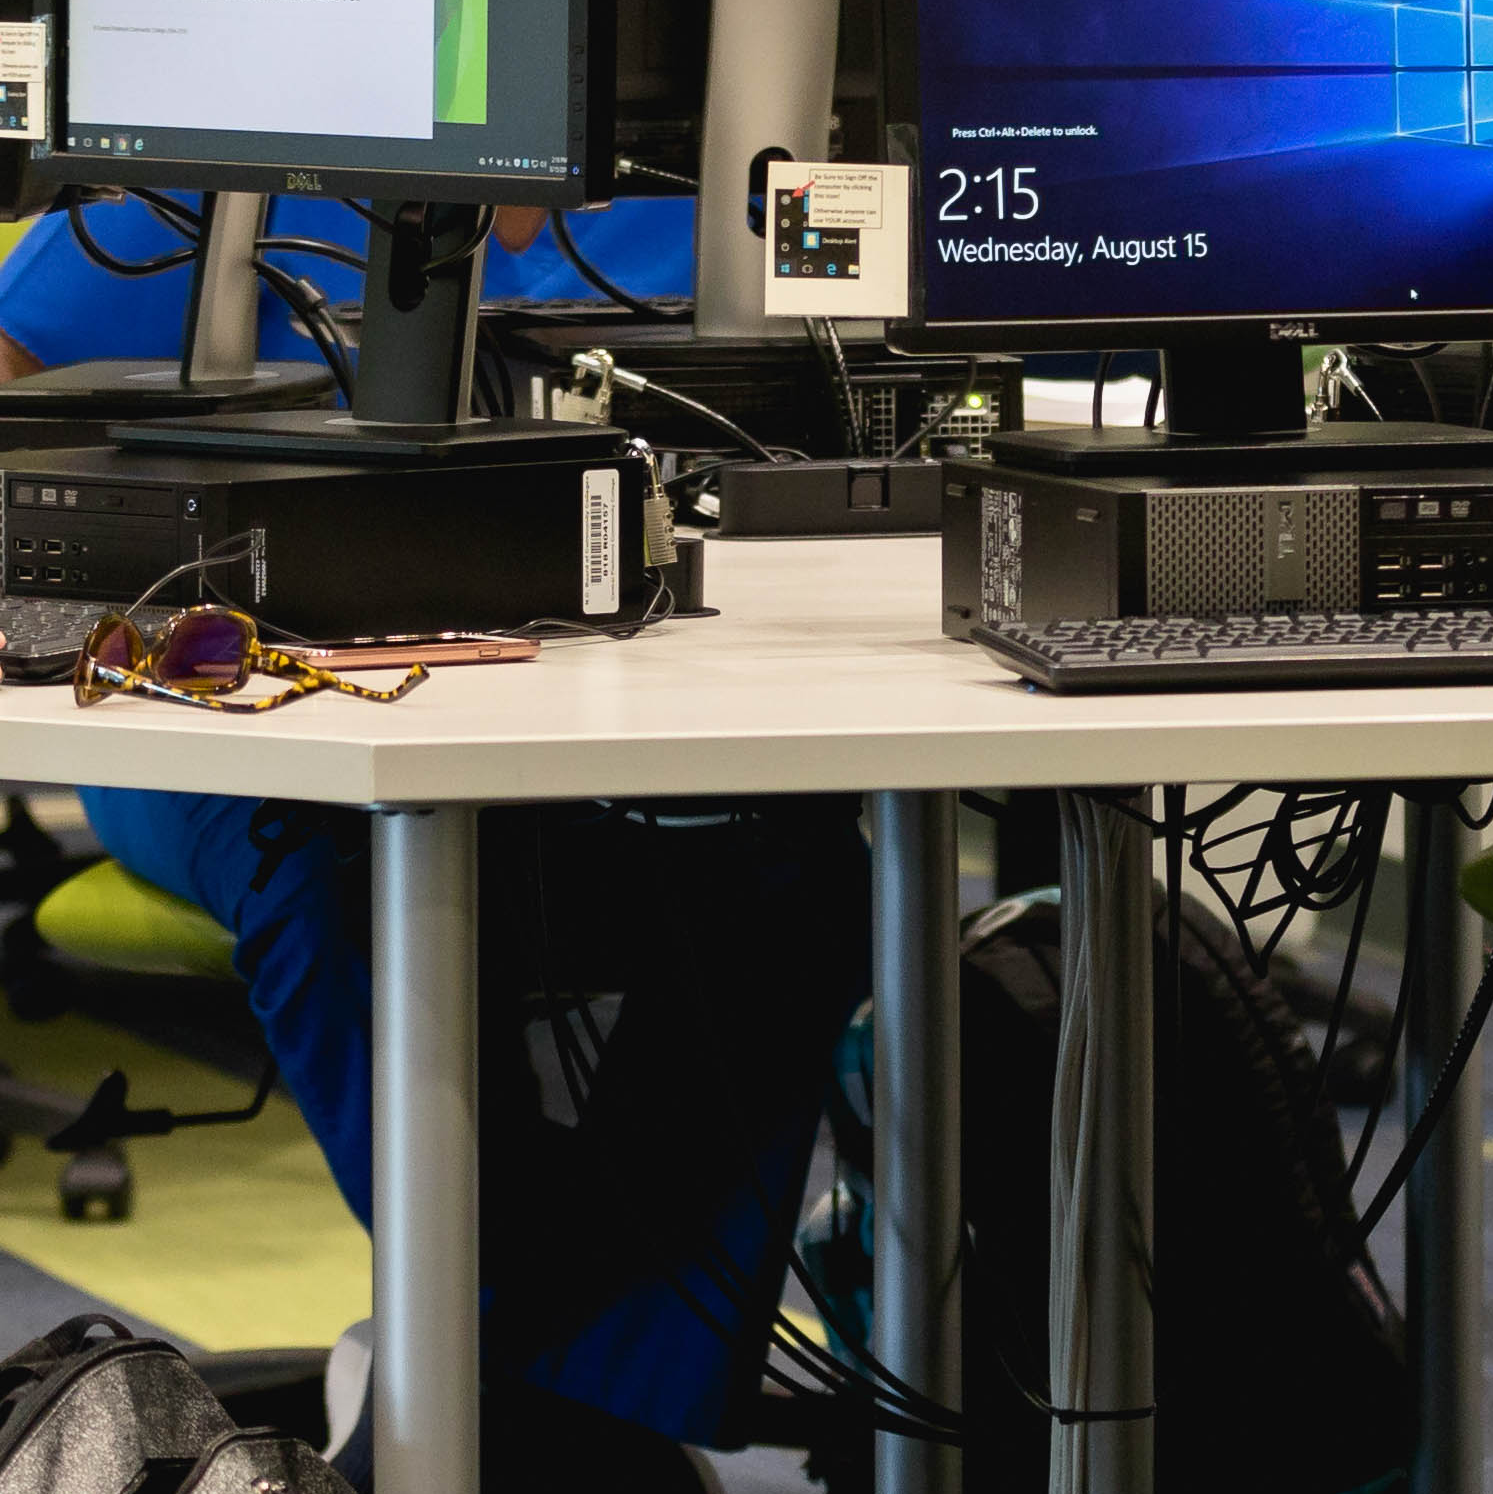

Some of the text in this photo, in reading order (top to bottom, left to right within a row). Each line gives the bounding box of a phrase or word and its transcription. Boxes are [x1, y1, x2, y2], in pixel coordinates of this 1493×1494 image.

[952, 126, 1098, 138] Press Ctrl+Alt+Delete to unlock.
[938, 167, 1039, 221] 2:15
[938, 233, 1207, 267] Wednesday, August 15
